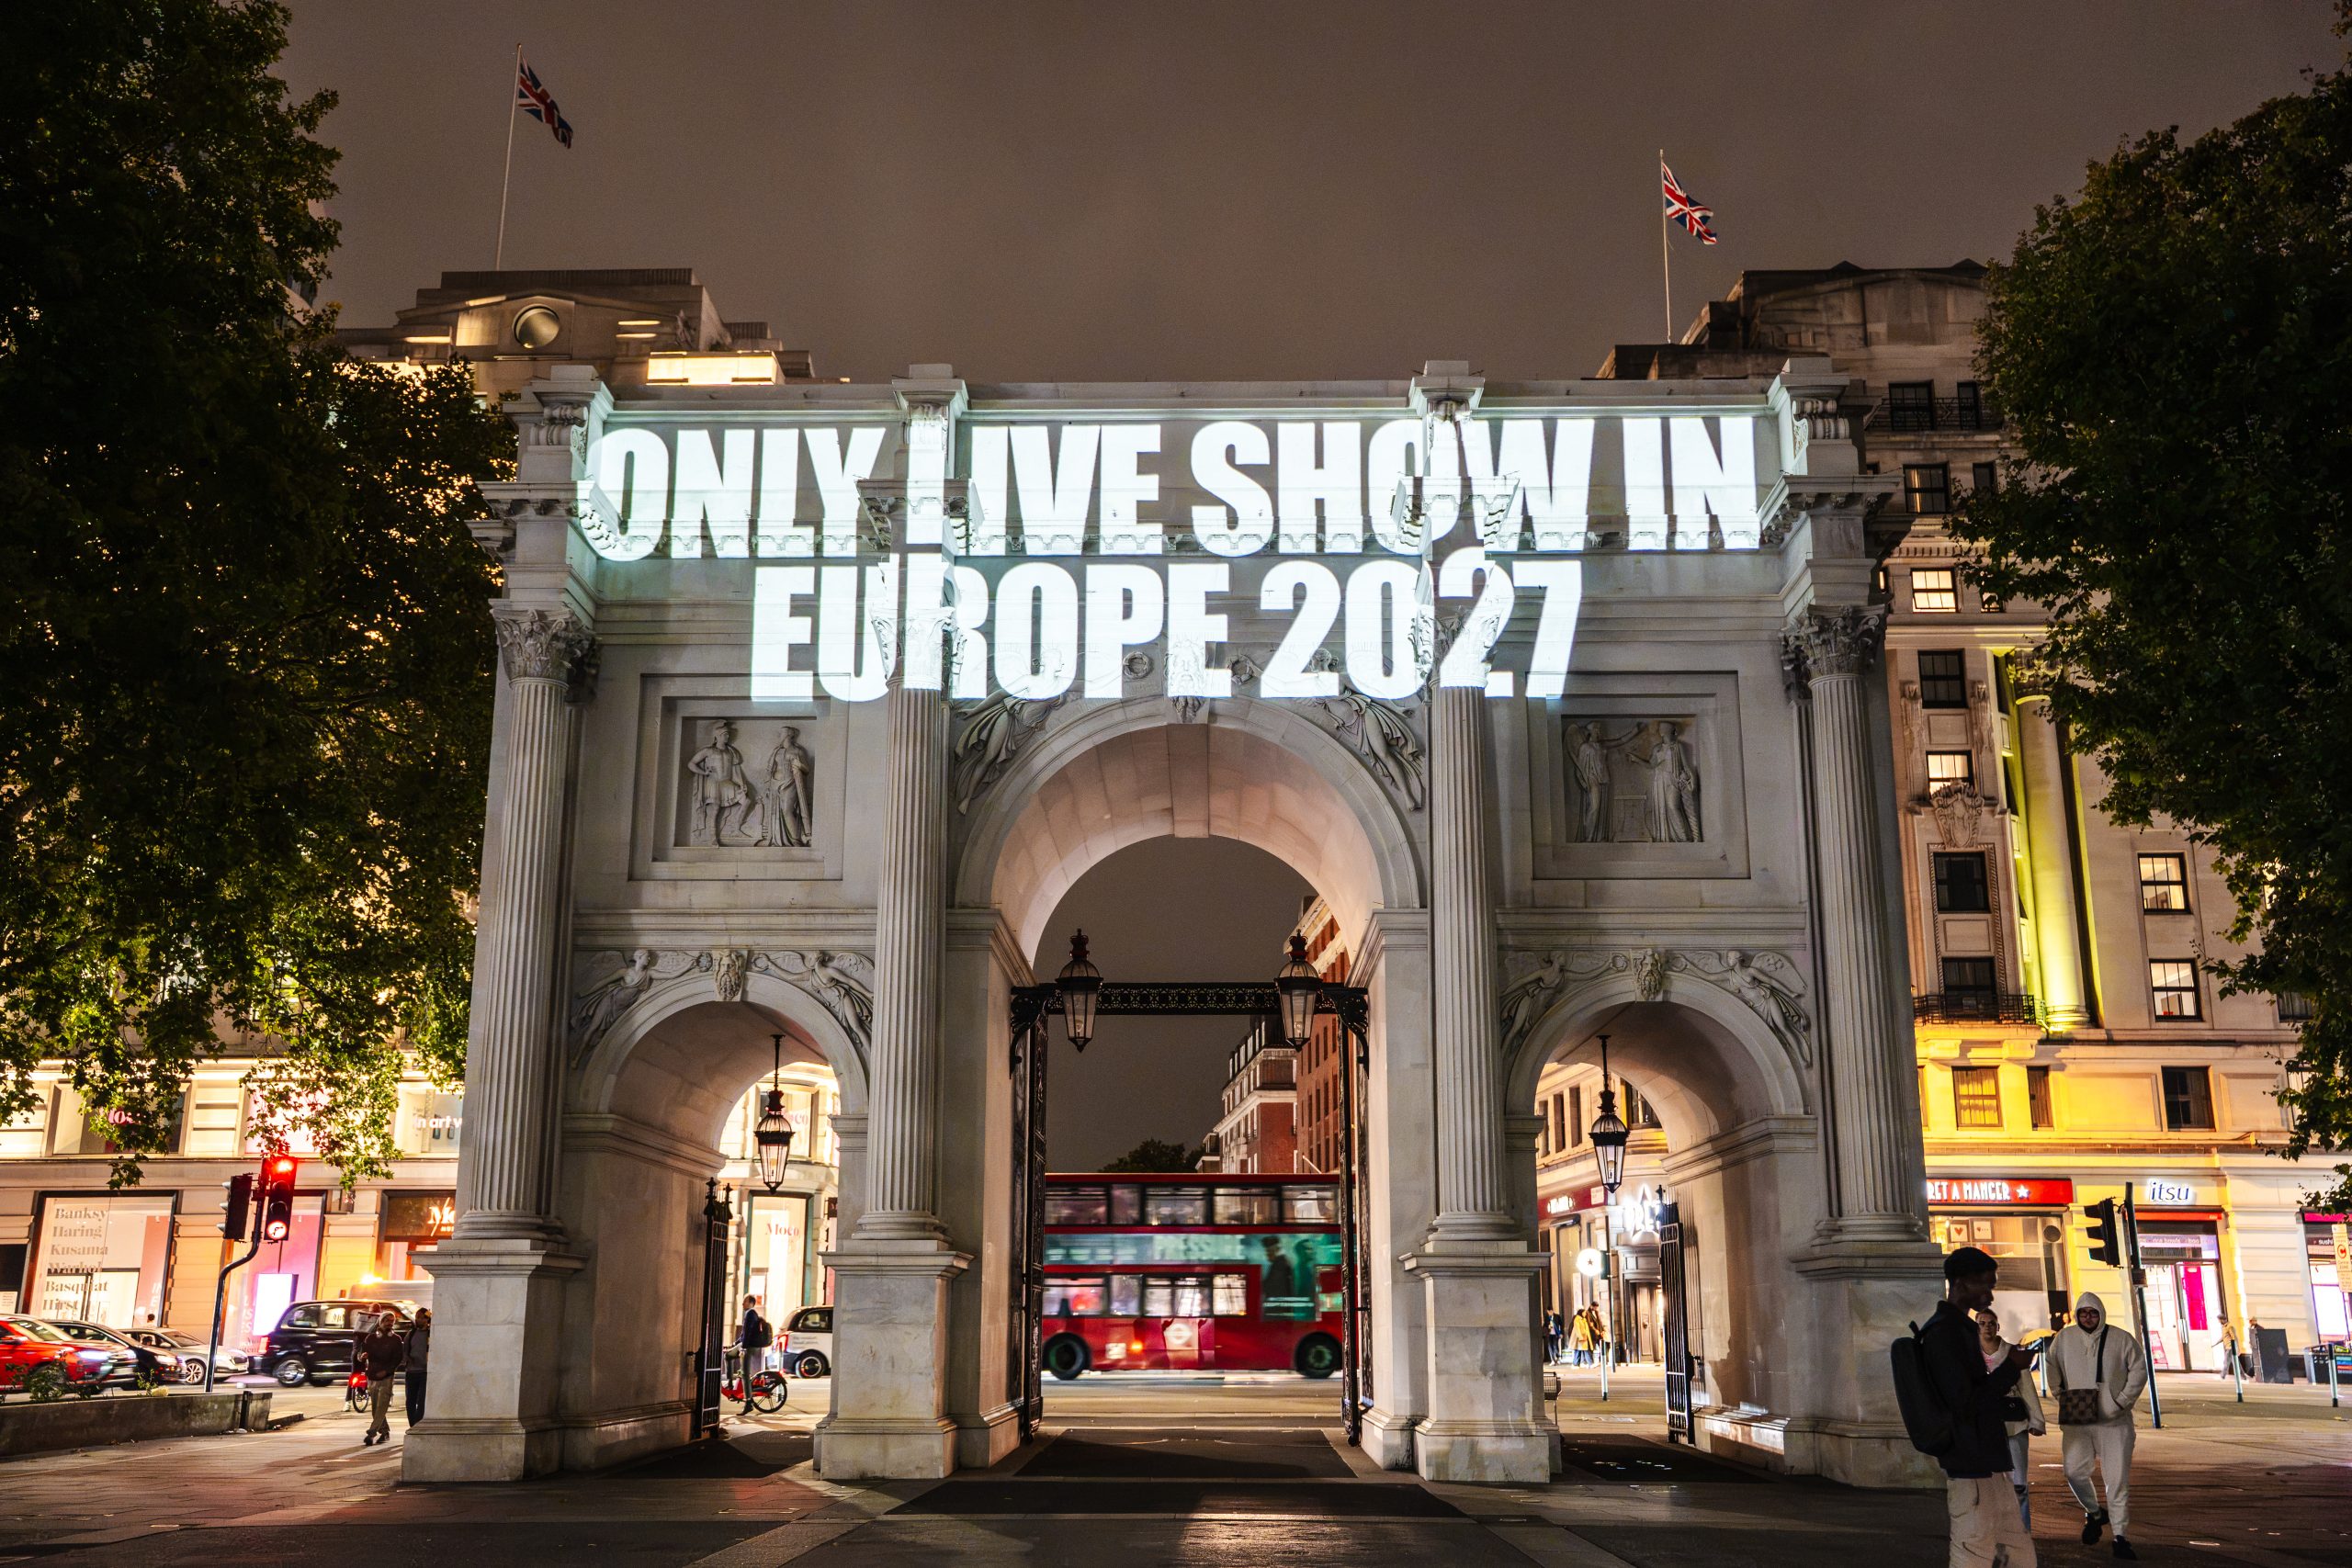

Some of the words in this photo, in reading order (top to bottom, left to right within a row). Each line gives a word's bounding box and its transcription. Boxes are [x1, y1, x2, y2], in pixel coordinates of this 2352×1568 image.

[577, 427, 886, 562] ONLY
[905, 418, 1163, 556] LIVE
[1191, 418, 1596, 558] SHOW
[1623, 416, 1761, 551] IN
[750, 554, 1233, 703] EUROPE
[1260, 547, 1583, 701] 2027
[1927, 1181, 1949, 1201] RET
[1951, 1182, 1961, 1201] A
[1962, 1181, 2011, 1201] MANGER
[2151, 1181, 2189, 1201] itsu
[55, 1207, 108, 1222] Banksy
[52, 1225, 103, 1239] Haring
[765, 1223, 799, 1236] Moco
[50, 1244, 108, 1256] Kusama
[47, 1261, 103, 1274] Warhol
[45, 1280, 108, 1294] Basquiat
[42, 1298, 79, 1311] Hirst
